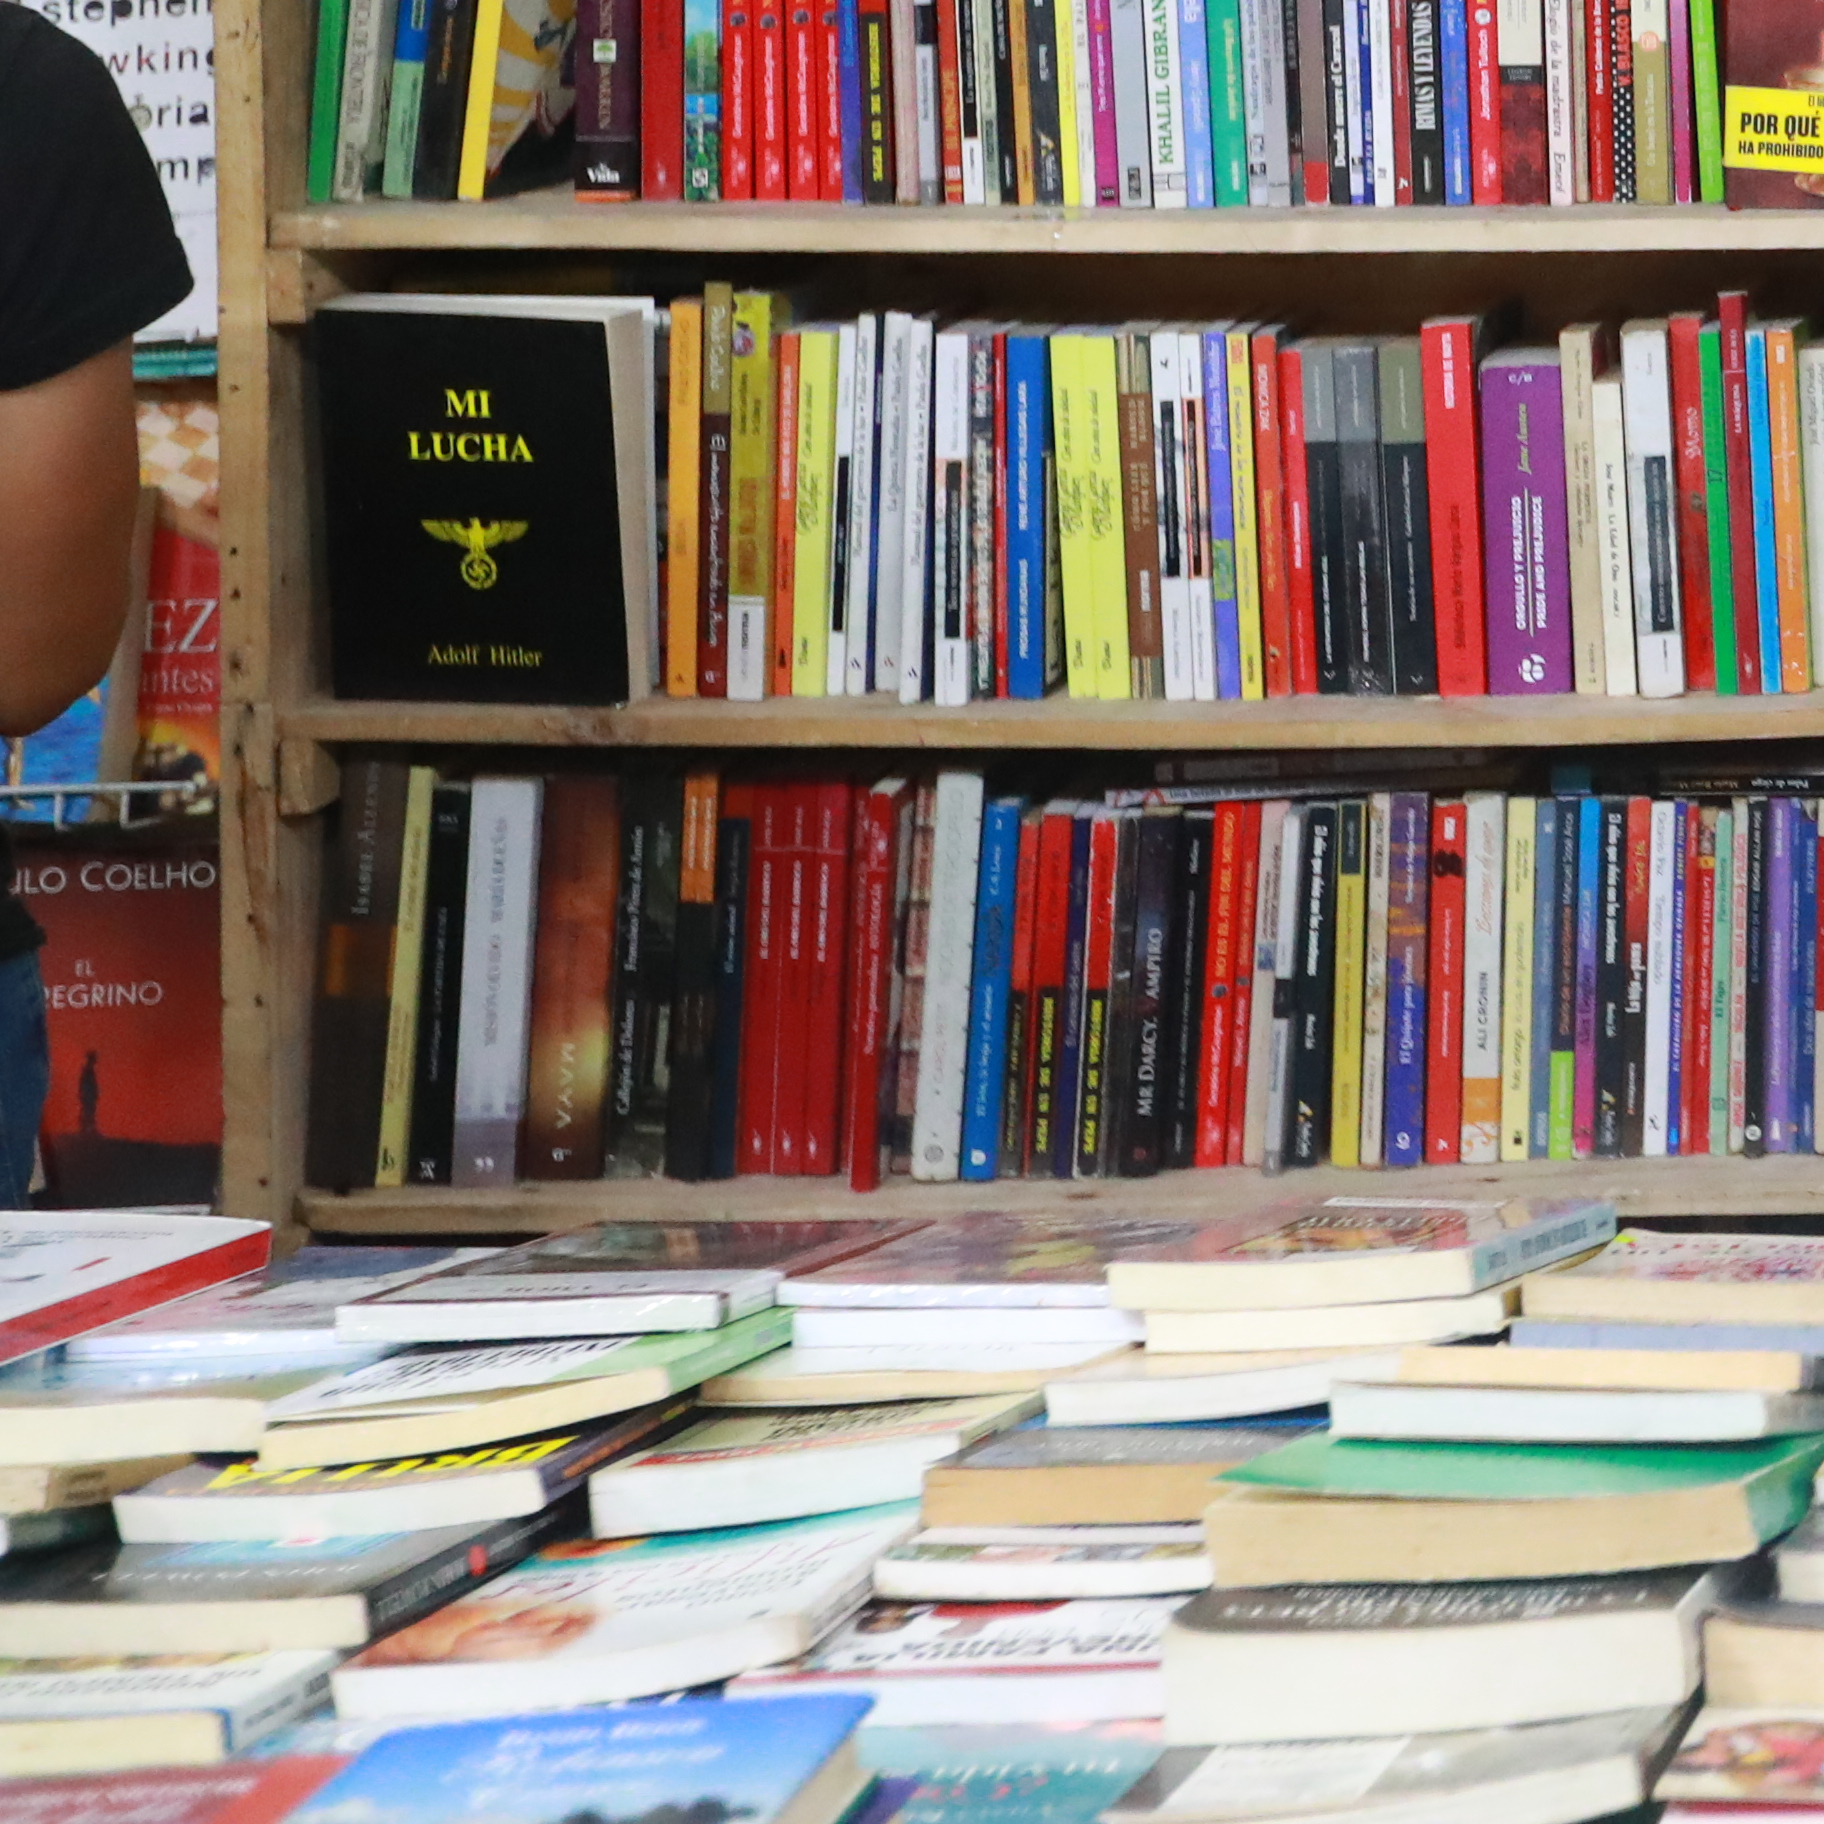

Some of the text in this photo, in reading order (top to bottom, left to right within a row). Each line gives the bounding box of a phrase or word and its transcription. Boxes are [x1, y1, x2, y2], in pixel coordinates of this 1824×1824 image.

[1154, 84, 1175, 164] KHALIL
[1741, 112, 1778, 135] POR
[1784, 110, 1819, 138] QUÉ
[1738, 142, 1755, 156] HA
[1758, 143, 1824, 158] PROHIBIDO
[446, 389, 492, 418] MI
[408, 431, 534, 463] LUCHA
[427, 642, 543, 668] Adolf Hitler
